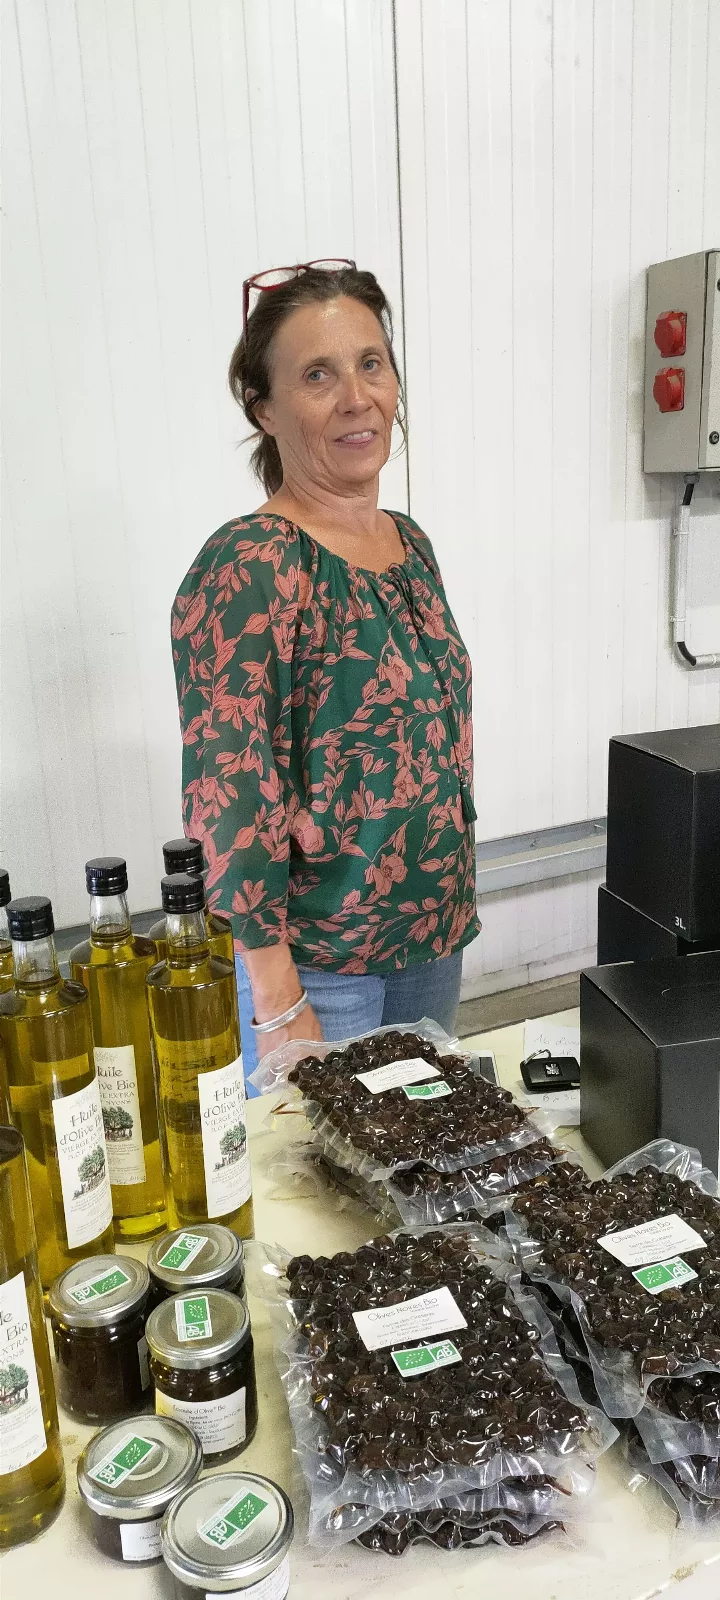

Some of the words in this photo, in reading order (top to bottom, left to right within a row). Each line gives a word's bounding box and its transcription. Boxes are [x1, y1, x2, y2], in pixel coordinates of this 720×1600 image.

[117, 1080, 135, 1090] Bio
[214, 1080, 240, 1101] Huile
[69, 1103, 98, 1127] Huile
[204, 1100, 236, 1118] d'Olive
[205, 1114, 232, 1126] VIERGE
[59, 1125, 94, 1146] d'Olive
[61, 1139, 89, 1154] VIERGE
[612, 1233, 636, 1243] Olives
[634, 1225, 657, 1235] Noires
[657, 1221, 671, 1229] Bio
[185, 1236, 199, 1250] AB
[673, 1264, 688, 1277] AB
[75, 1286, 91, 1300] AB
[368, 1310, 396, 1321] Olives
[396, 1303, 423, 1314] Noires
[423, 1298, 438, 1306] Bio
[6, 1321, 28, 1341] Bio
[186, 1325, 200, 1337] AB
[0, 1335, 29, 1355] XTRA
[0, 1349, 25, 1365] YONS
[436, 1347, 453, 1360] AB
[100, 1464, 115, 1480] AB
[210, 1520, 228, 1538] AB
